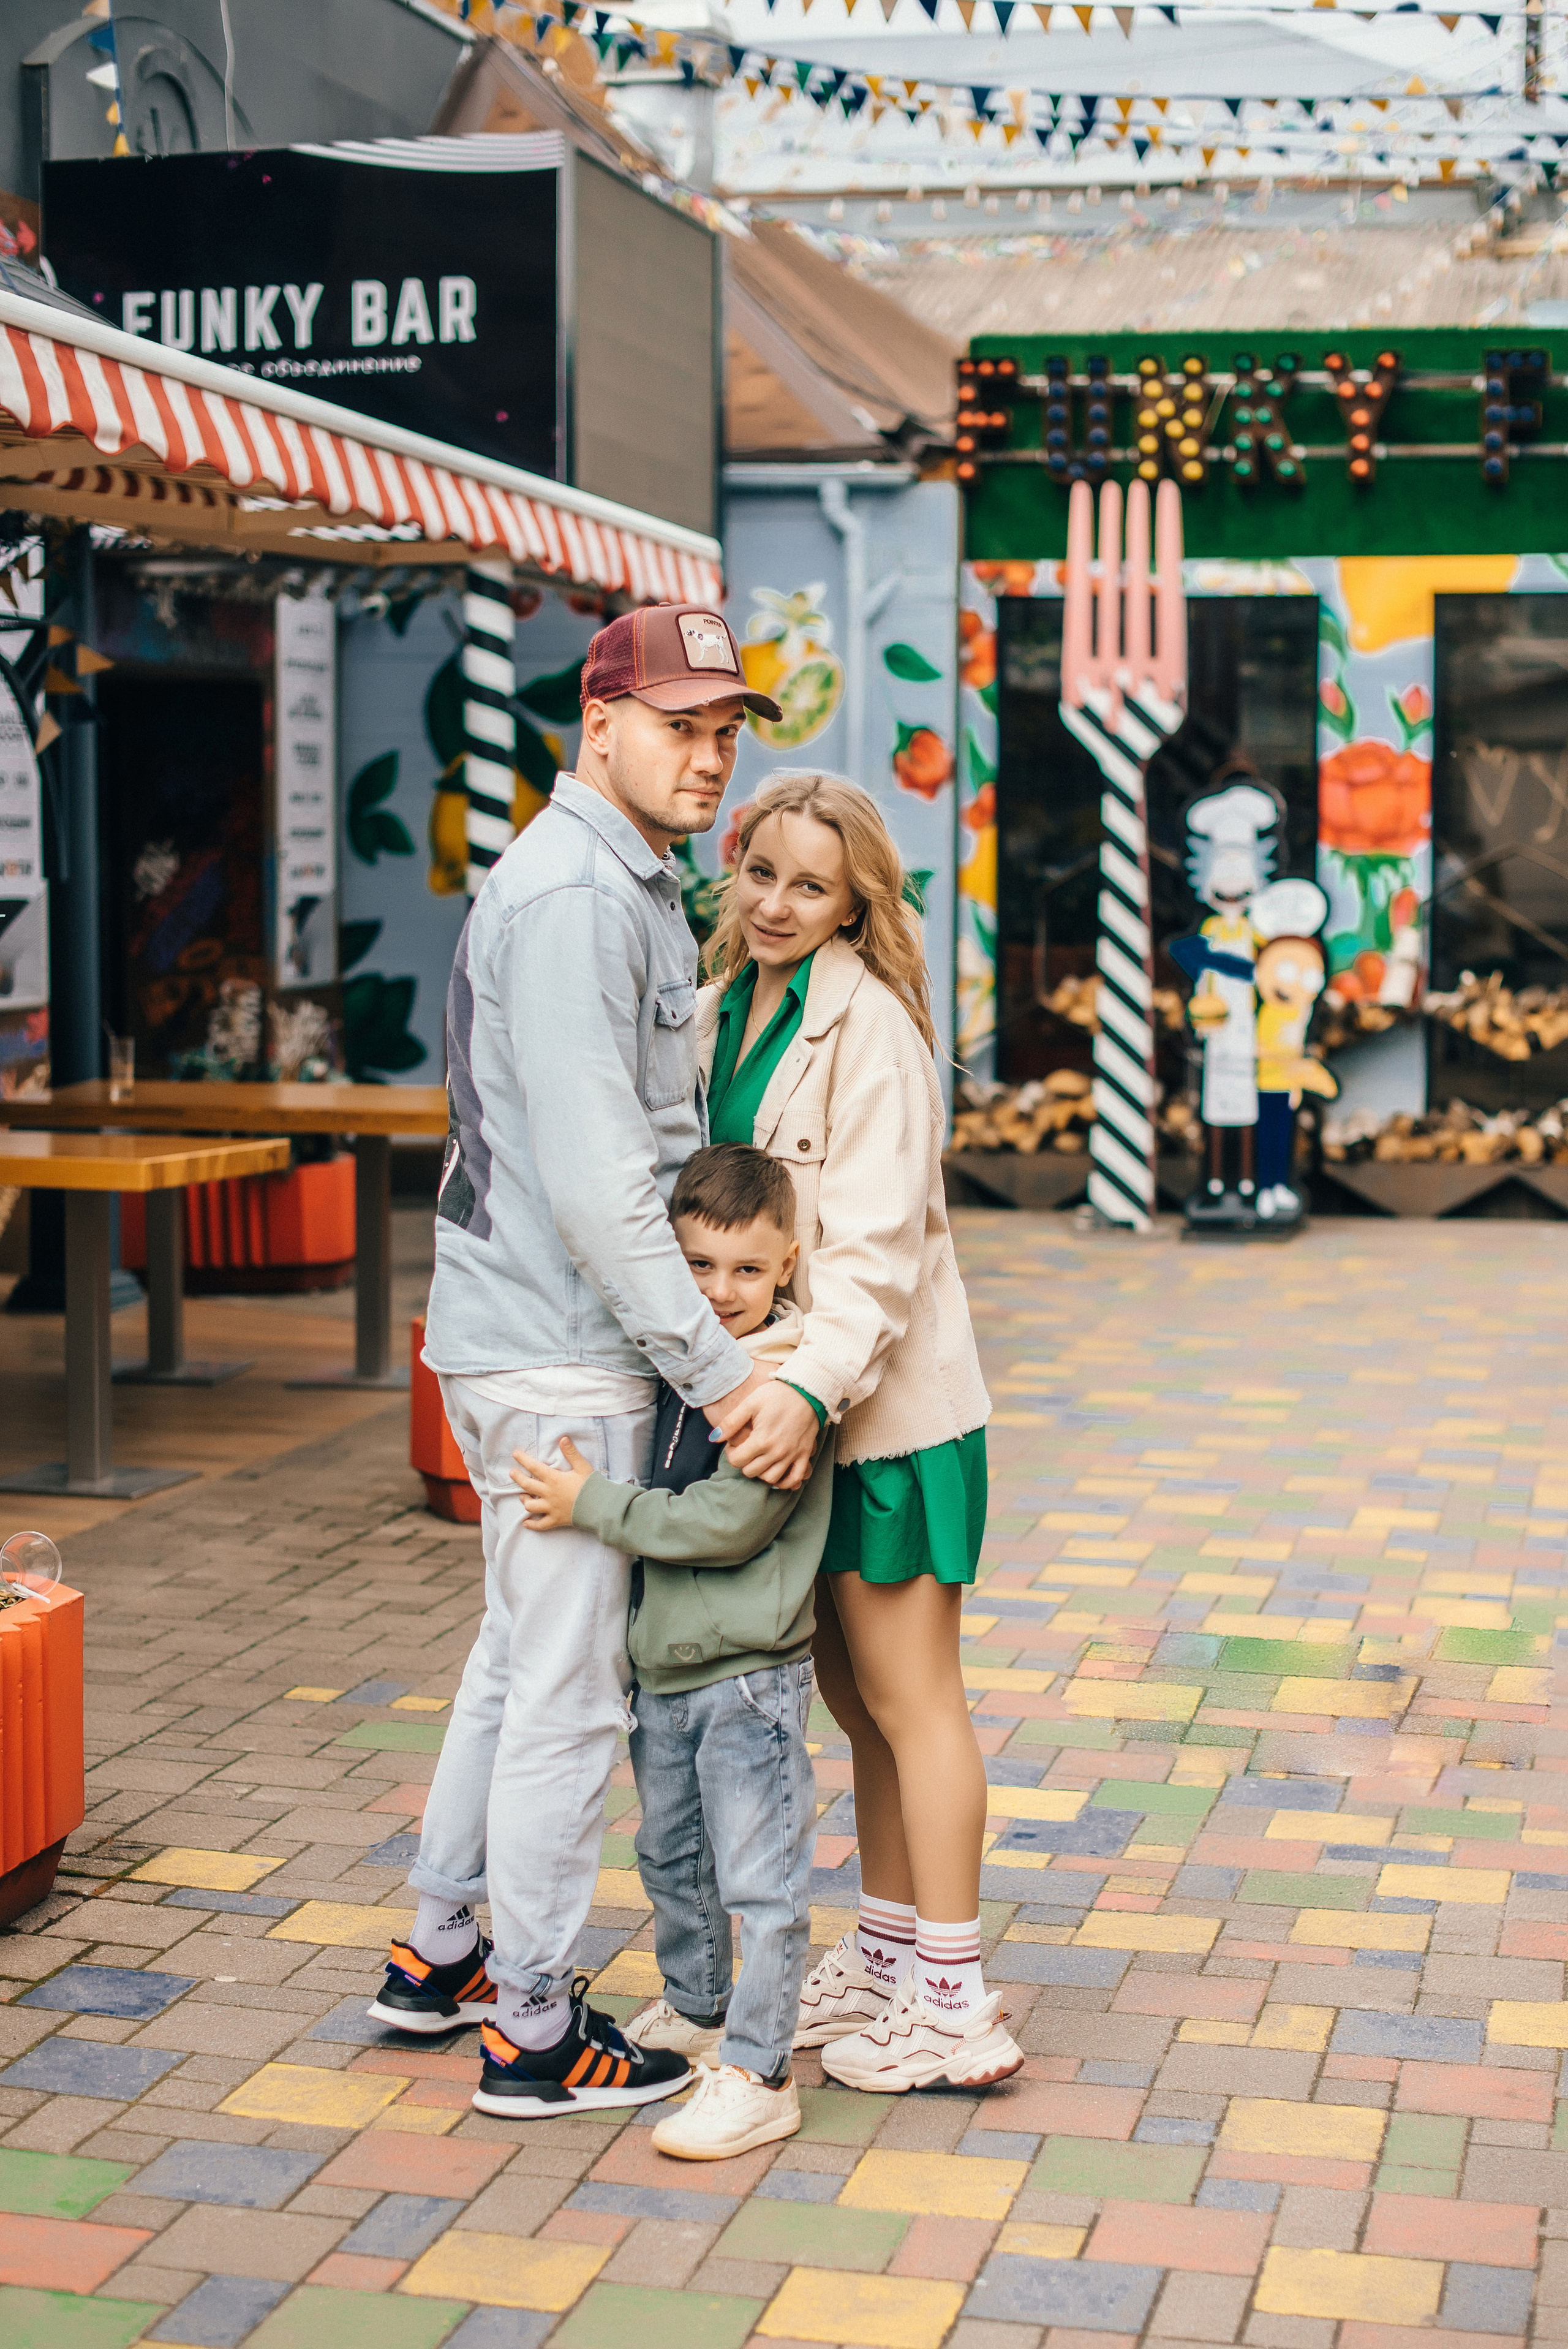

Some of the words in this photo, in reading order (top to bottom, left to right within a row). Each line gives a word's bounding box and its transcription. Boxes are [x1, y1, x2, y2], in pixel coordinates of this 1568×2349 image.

[122, 282, 325, 353] FUNKY
[350, 275, 478, 347] BAR
[957, 350, 1403, 483] FUNKY
[437, 1915, 475, 1931] adidas
[864, 1964, 897, 1984] didas
[512, 2000, 557, 2018] adidas
[924, 1994, 970, 2010] adidas
